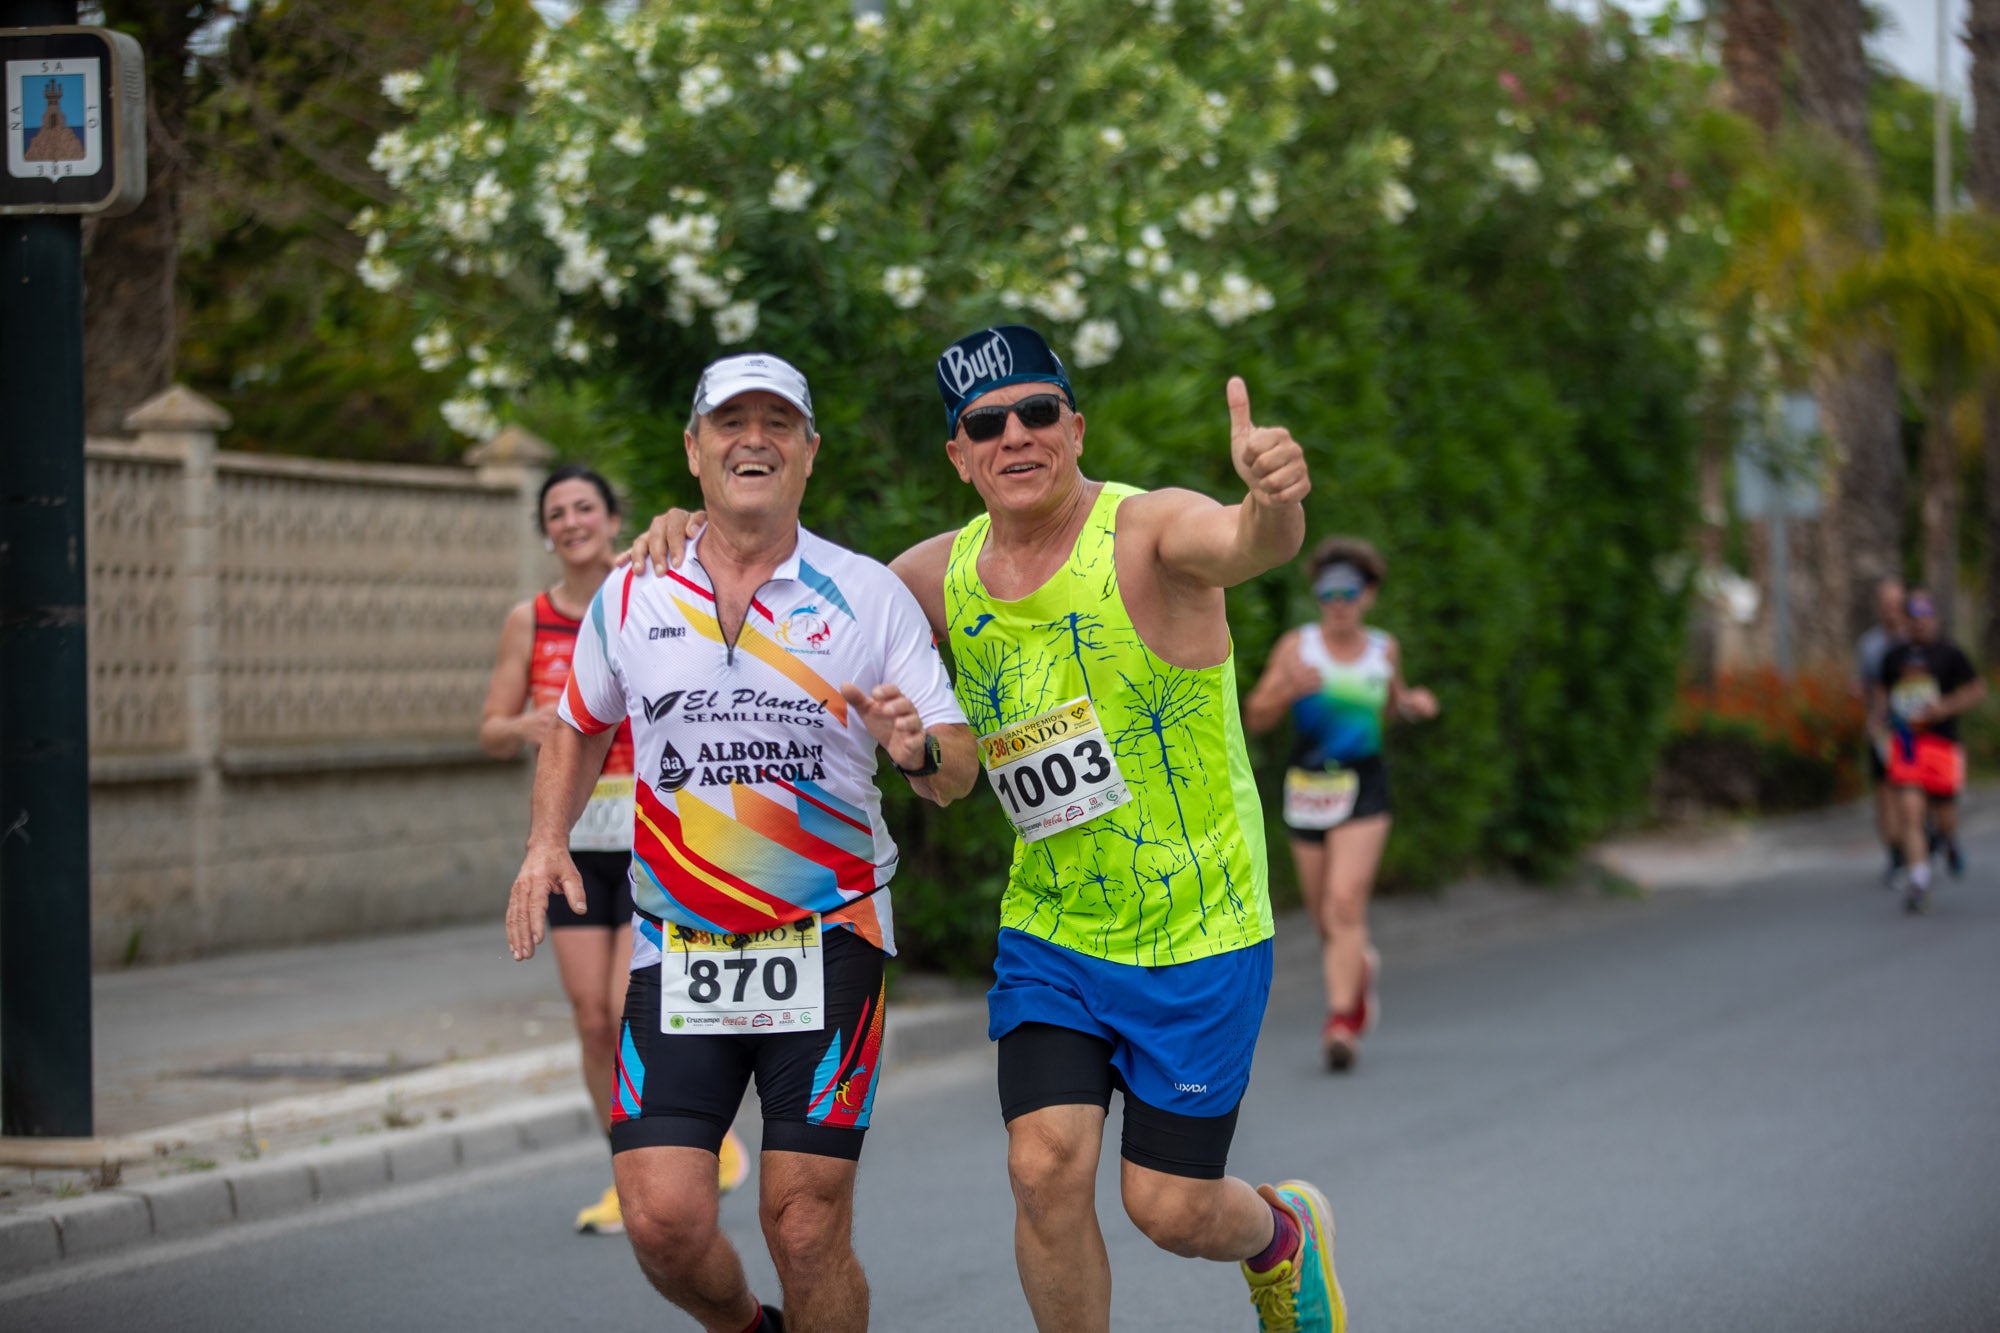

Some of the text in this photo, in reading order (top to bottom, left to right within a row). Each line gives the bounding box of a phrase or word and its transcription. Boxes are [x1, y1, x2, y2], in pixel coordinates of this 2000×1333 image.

[683, 688, 829, 715] El Plantel
[683, 712, 825, 728] SEMILLEROS
[1024, 715, 1057, 732] PREMIO
[993, 737, 1007, 758] 38
[1005, 720, 1068, 756] FONDO
[699, 762, 827, 787] AGRICOLA
[998, 739, 1111, 814] 1003
[688, 956, 798, 1004] 870
